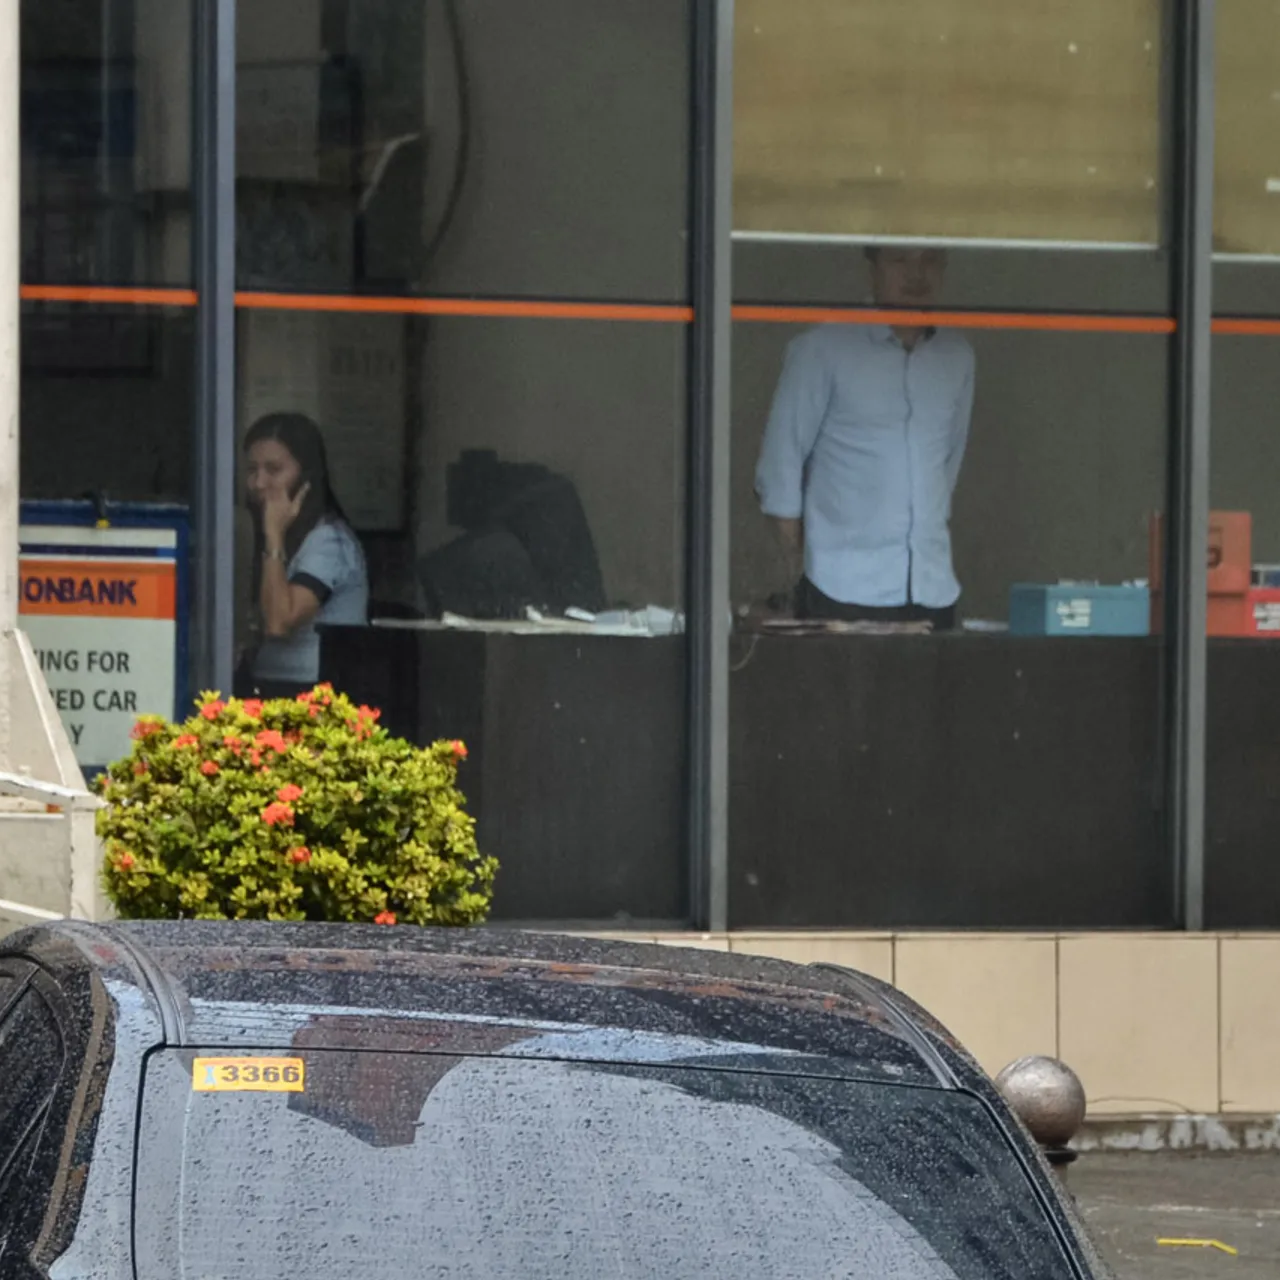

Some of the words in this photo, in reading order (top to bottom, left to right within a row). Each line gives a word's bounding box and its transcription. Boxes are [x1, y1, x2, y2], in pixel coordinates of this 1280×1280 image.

[34, 649, 79, 673] ING
[87, 650, 131, 673] FOR
[49, 687, 86, 711] ED
[93, 689, 137, 711] CAR
[221, 1064, 300, 1083] 3366
